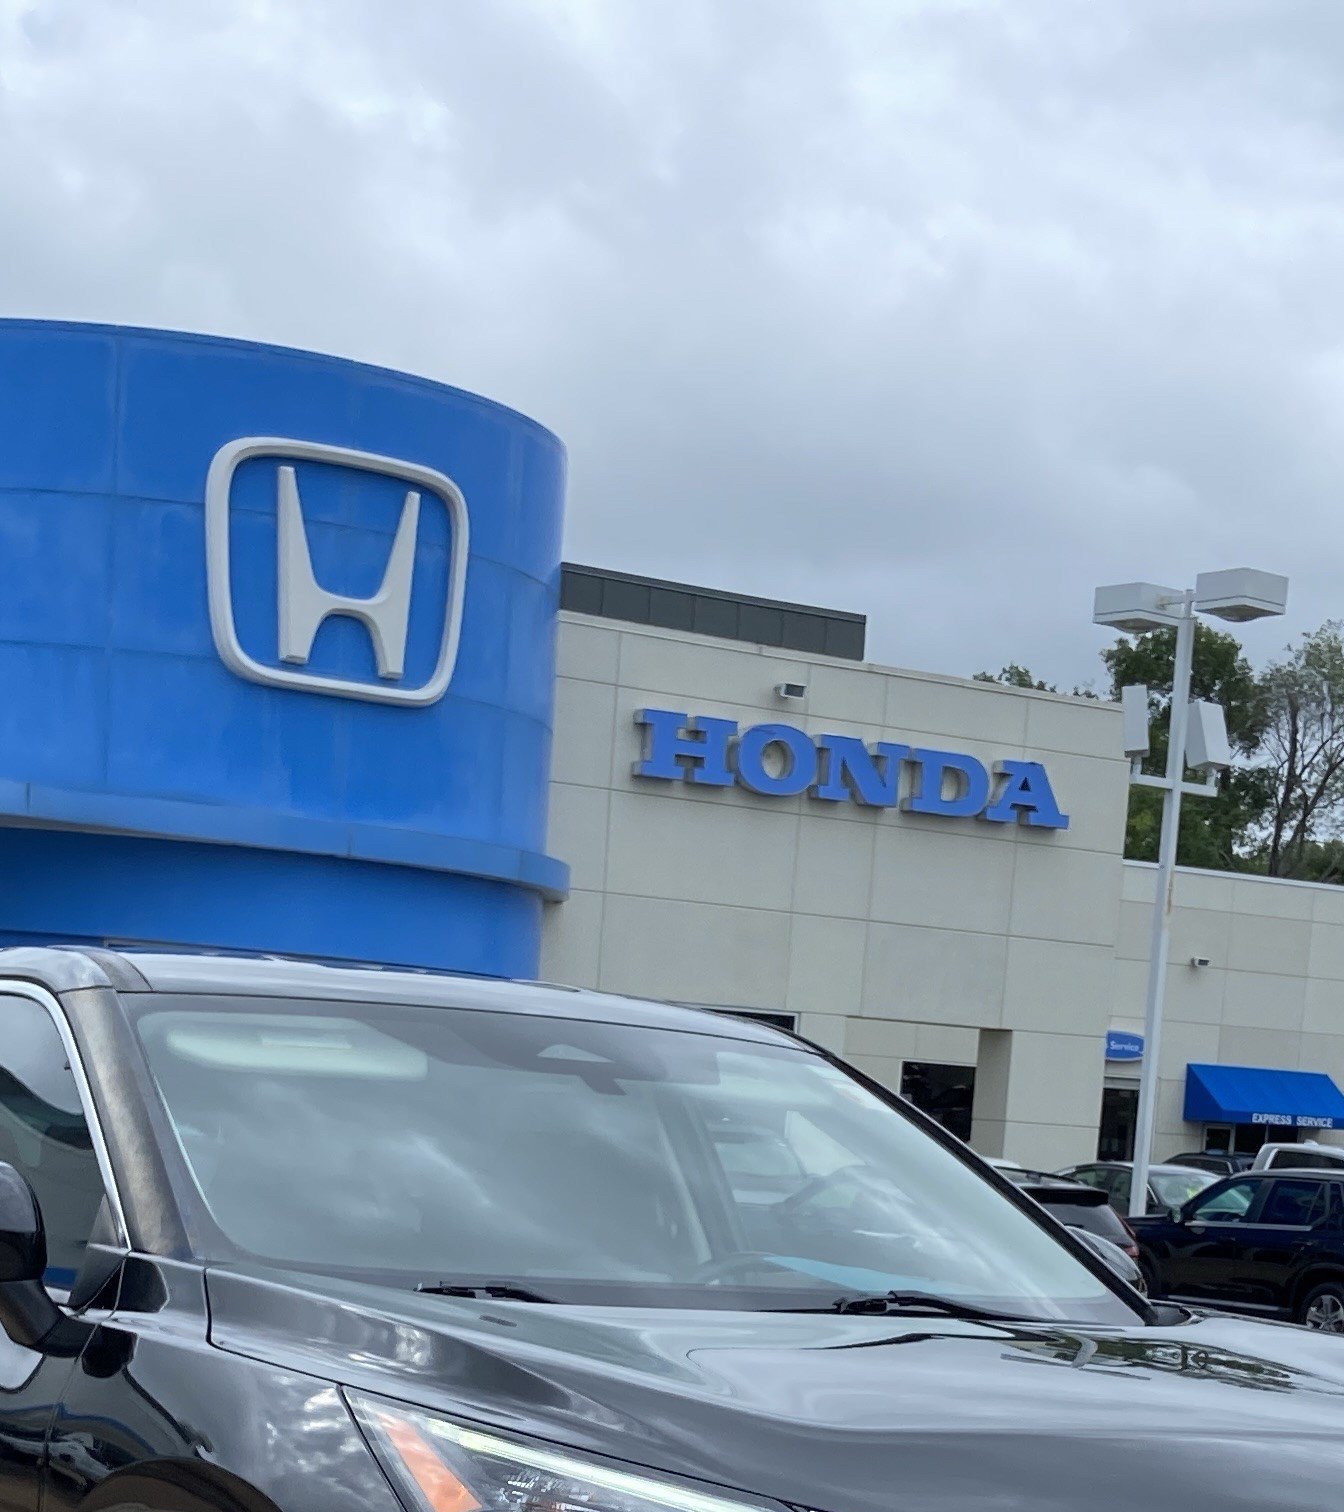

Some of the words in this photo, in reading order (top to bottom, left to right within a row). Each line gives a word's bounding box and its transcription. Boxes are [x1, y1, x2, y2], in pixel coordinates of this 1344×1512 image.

[633, 708, 1069, 830] HONDA
[1251, 1112, 1292, 1126] EXPRESS
[1296, 1115, 1334, 1129] SERVICE
